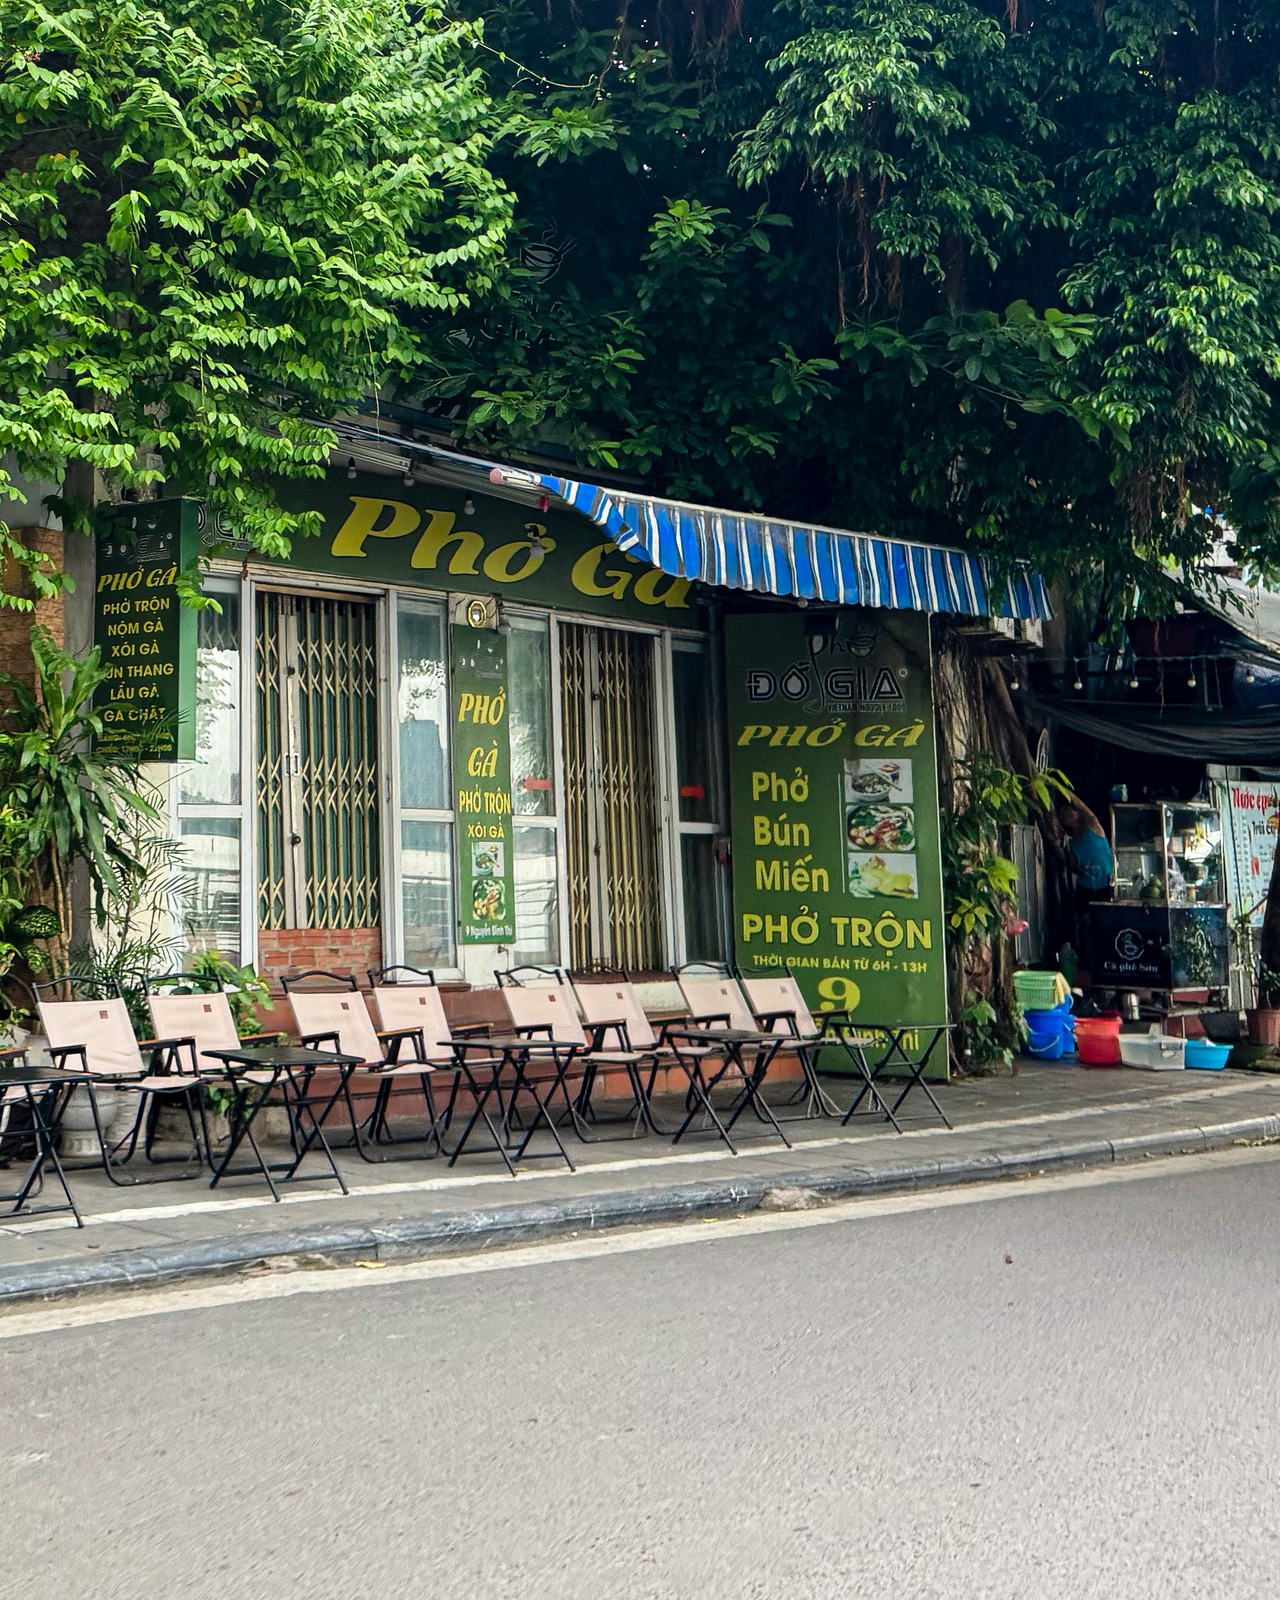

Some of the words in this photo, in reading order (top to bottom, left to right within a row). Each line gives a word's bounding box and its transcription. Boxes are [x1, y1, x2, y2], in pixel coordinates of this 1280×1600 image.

[331, 496, 557, 583] Phở
[97, 565, 145, 593] PHỞ
[146, 562, 178, 588] GÀ
[134, 596, 170, 615] TRỘN
[143, 617, 164, 633] GÀ
[140, 639, 160, 655] GÀ
[127, 663, 175, 678] THANG
[139, 682, 160, 698] GÀ
[458, 686, 506, 726] PHỞ
[737, 718, 847, 747] PHỞ
[853, 718, 926, 747] GÀ
[467, 740, 498, 778] GÀ
[752, 766, 809, 802] Phở
[753, 812, 810, 847] Bún
[755, 854, 830, 892] Miến
[743, 905, 820, 945] PHỞ
[831, 910, 932, 957] TRỘN
[786, 956, 819, 968] GIAN
[872, 959, 891, 971] 6H
[901, 961, 928, 974] 13H
[817, 976, 860, 1013] 9
